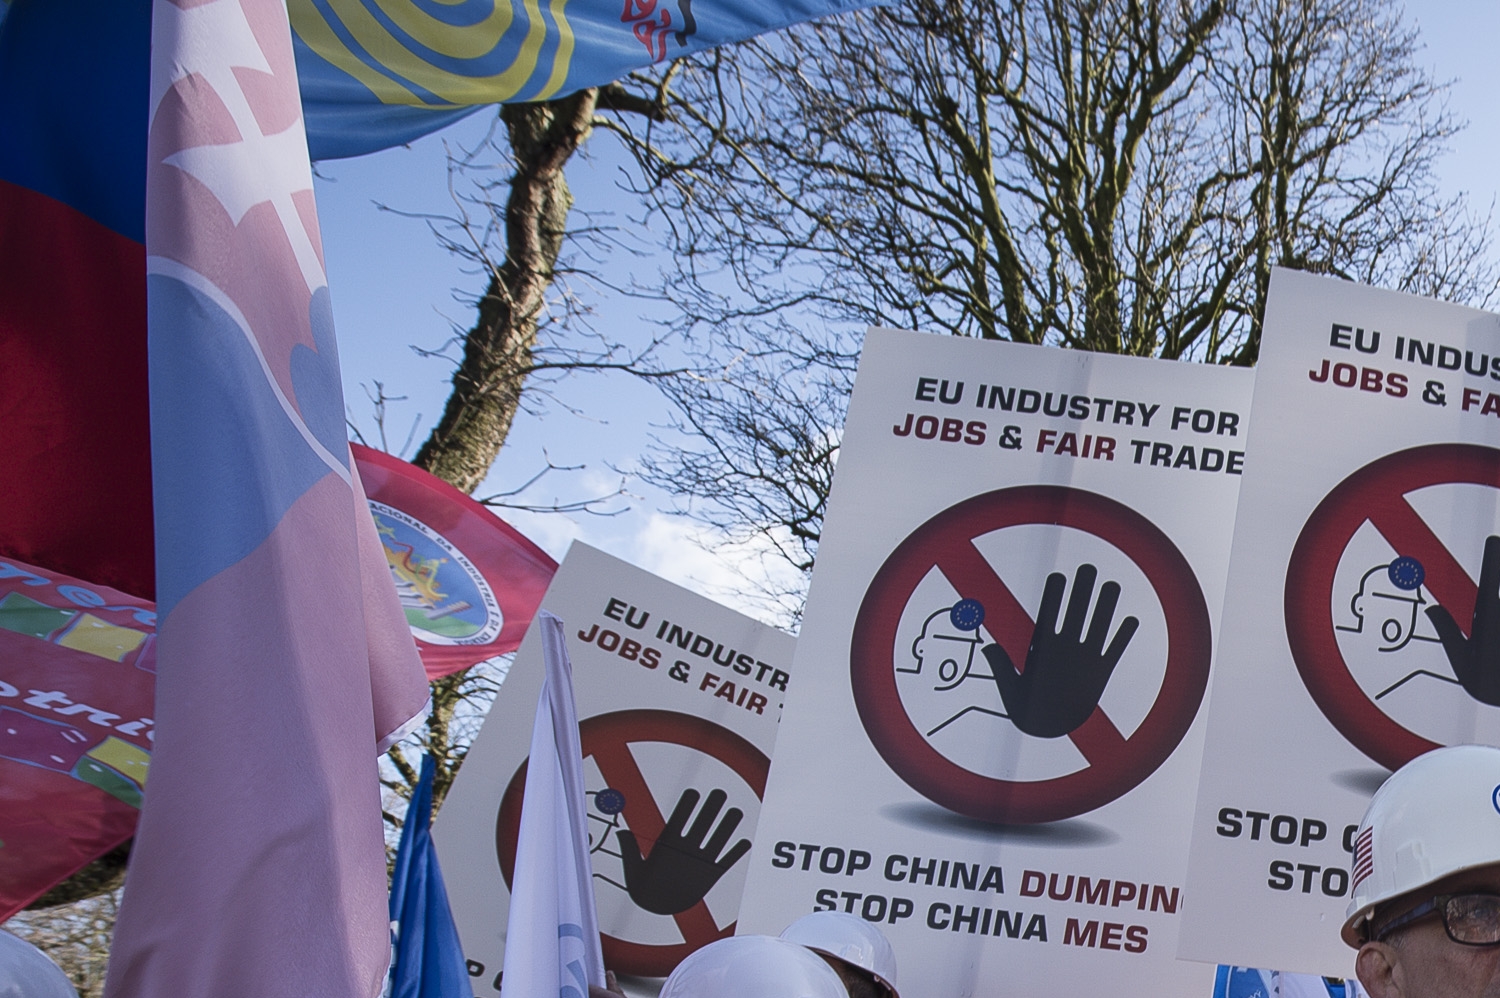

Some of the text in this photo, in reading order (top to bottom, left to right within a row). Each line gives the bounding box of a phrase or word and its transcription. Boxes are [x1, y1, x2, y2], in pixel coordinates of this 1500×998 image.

[1330, 323, 1380, 354] EU
[915, 377, 1239, 436] EU INDUSTRY FOR
[1309, 360, 1408, 398] JOBS
[1423, 381, 1446, 407] &
[893, 414, 1245, 475] JOBS & FAIR TRADE
[370, 503, 429, 534] ACIONAL
[578, 624, 661, 669] JOBS
[669, 661, 690, 683] &
[699, 672, 767, 715] FAIR
[604, 598, 789, 692] EU INDUSTR
[1217, 808, 1327, 847] STOP
[772, 842, 1179, 914] STOP CHINA DUMPIN
[1268, 861, 1348, 897] STO
[814, 889, 1148, 953] STOP CHINA MES
